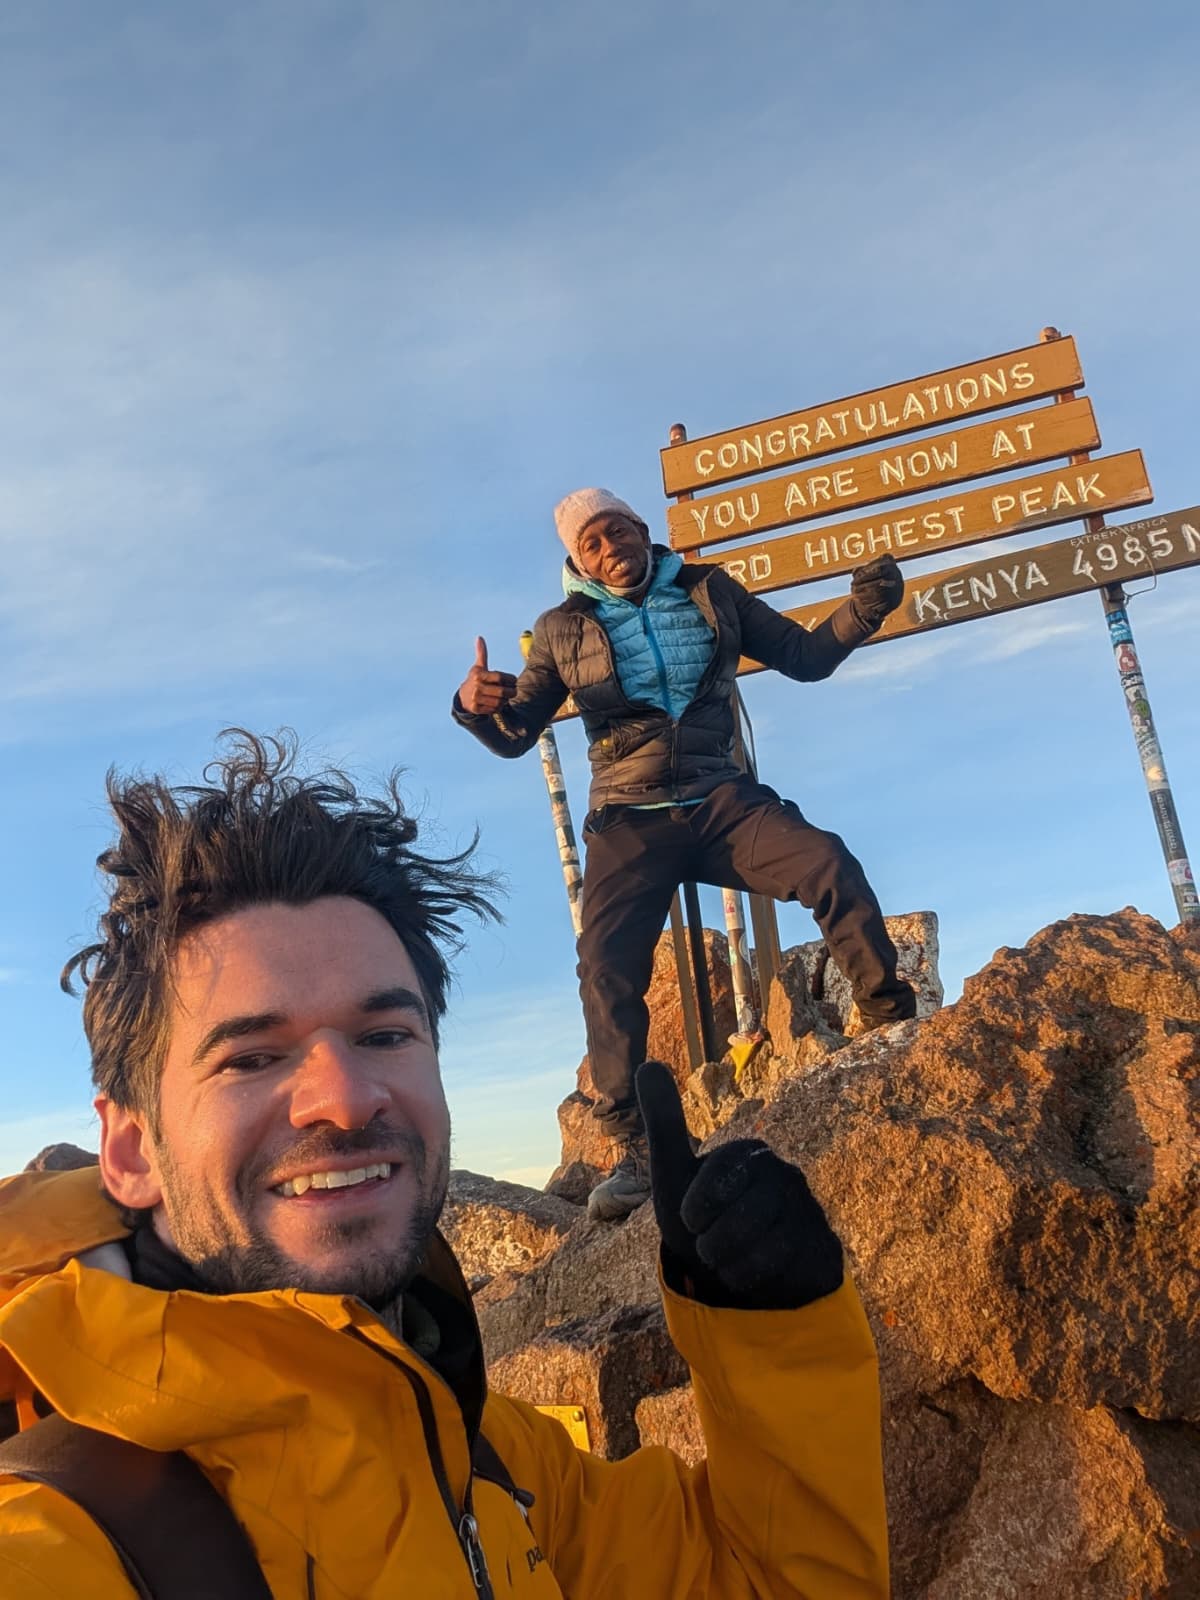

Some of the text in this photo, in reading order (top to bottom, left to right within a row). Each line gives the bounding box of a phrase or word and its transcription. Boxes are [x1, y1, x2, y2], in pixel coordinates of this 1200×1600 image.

[694, 362, 1034, 476] CONGRATULATIONS
[690, 422, 1035, 538] YOU ARE NOW AT
[803, 505, 965, 568] HIGHEST
[992, 473, 1106, 523] PEAK
[912, 561, 1049, 622] KENYA
[1072, 527, 1174, 583] 4985
[1070, 529, 1118, 547] EXTREK
